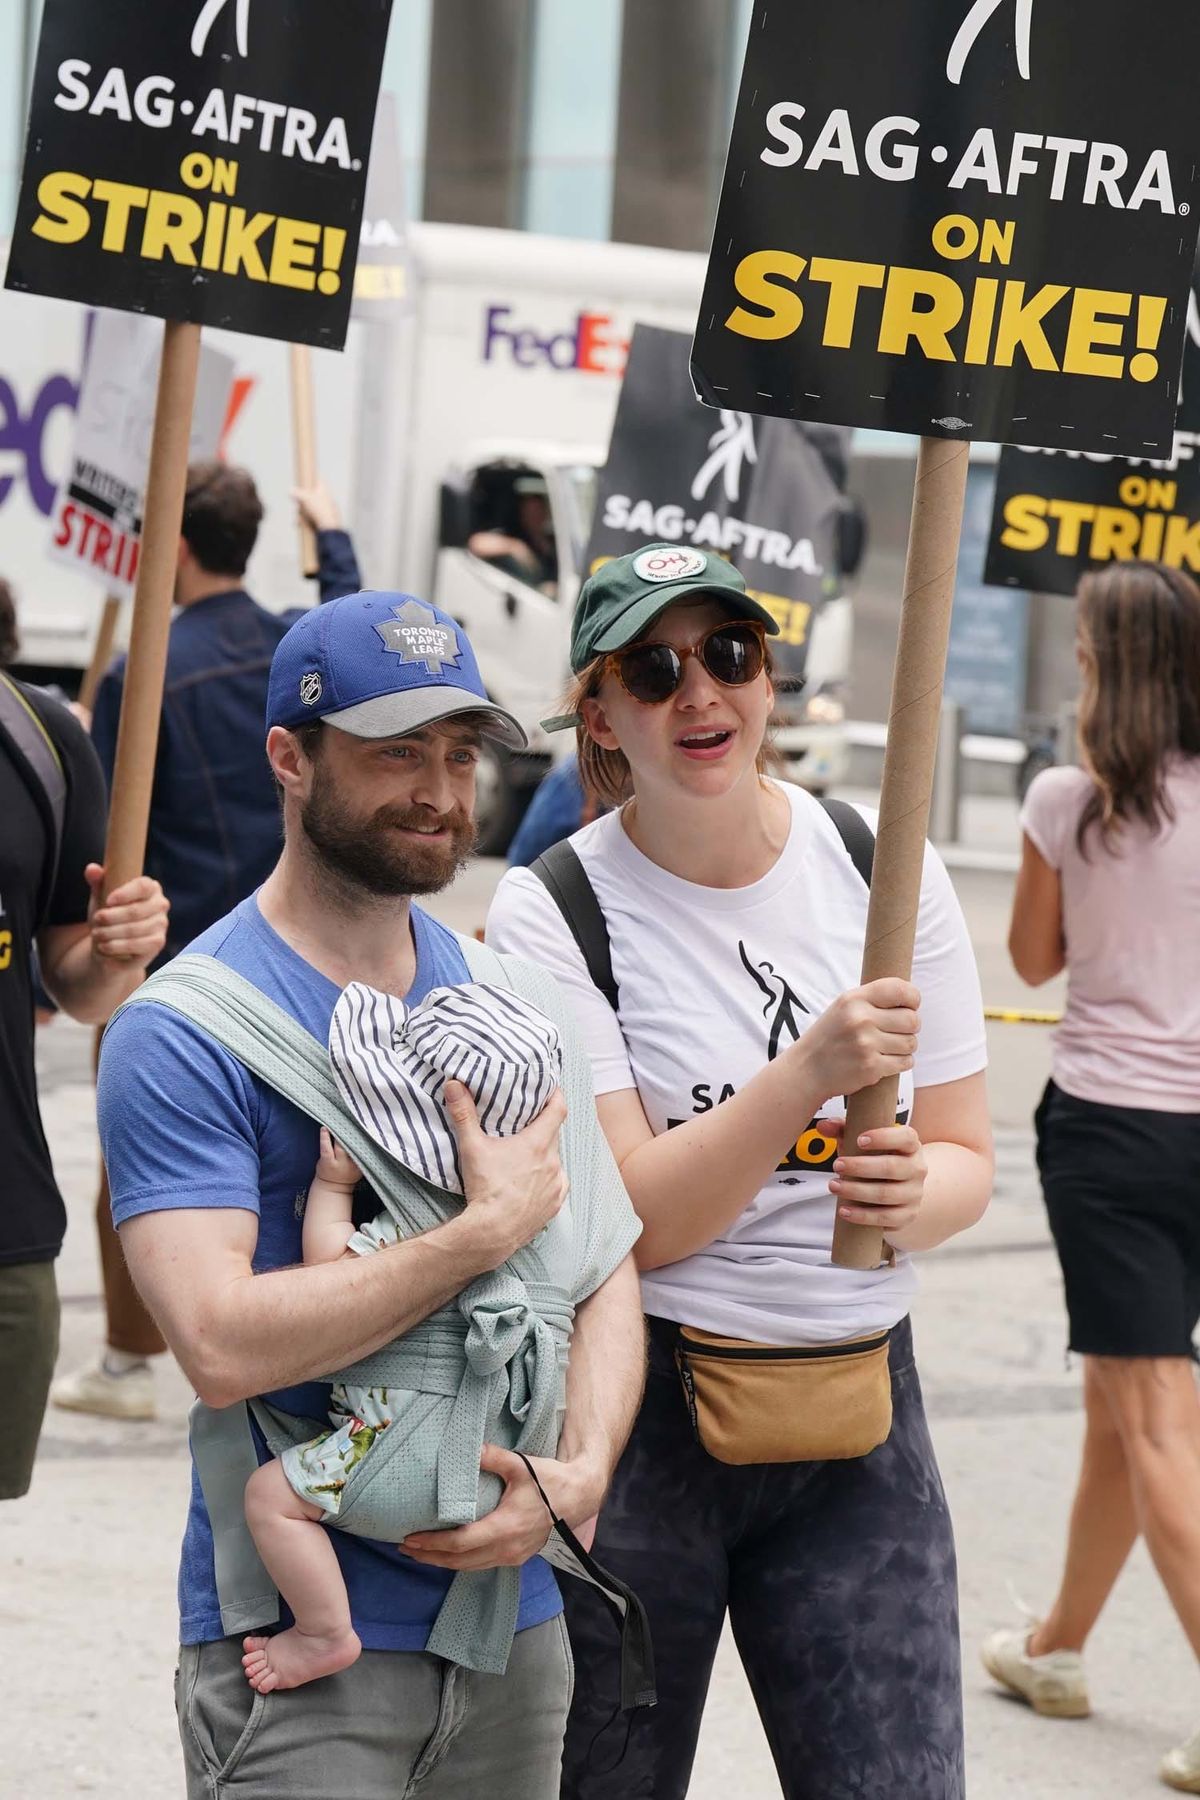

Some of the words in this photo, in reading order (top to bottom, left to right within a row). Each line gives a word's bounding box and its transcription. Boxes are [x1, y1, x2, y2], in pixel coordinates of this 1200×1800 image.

[180, 152, 239, 196] ON
[31, 171, 347, 296] STRIKE!
[931, 214, 1016, 265] ON
[724, 250, 1168, 383] STRIKE!
[1119, 475, 1178, 512] ON
[393, 626, 448, 640] TORONTO
[406, 635, 445, 647] MAPLE
[412, 644, 445, 656] LEAFS
